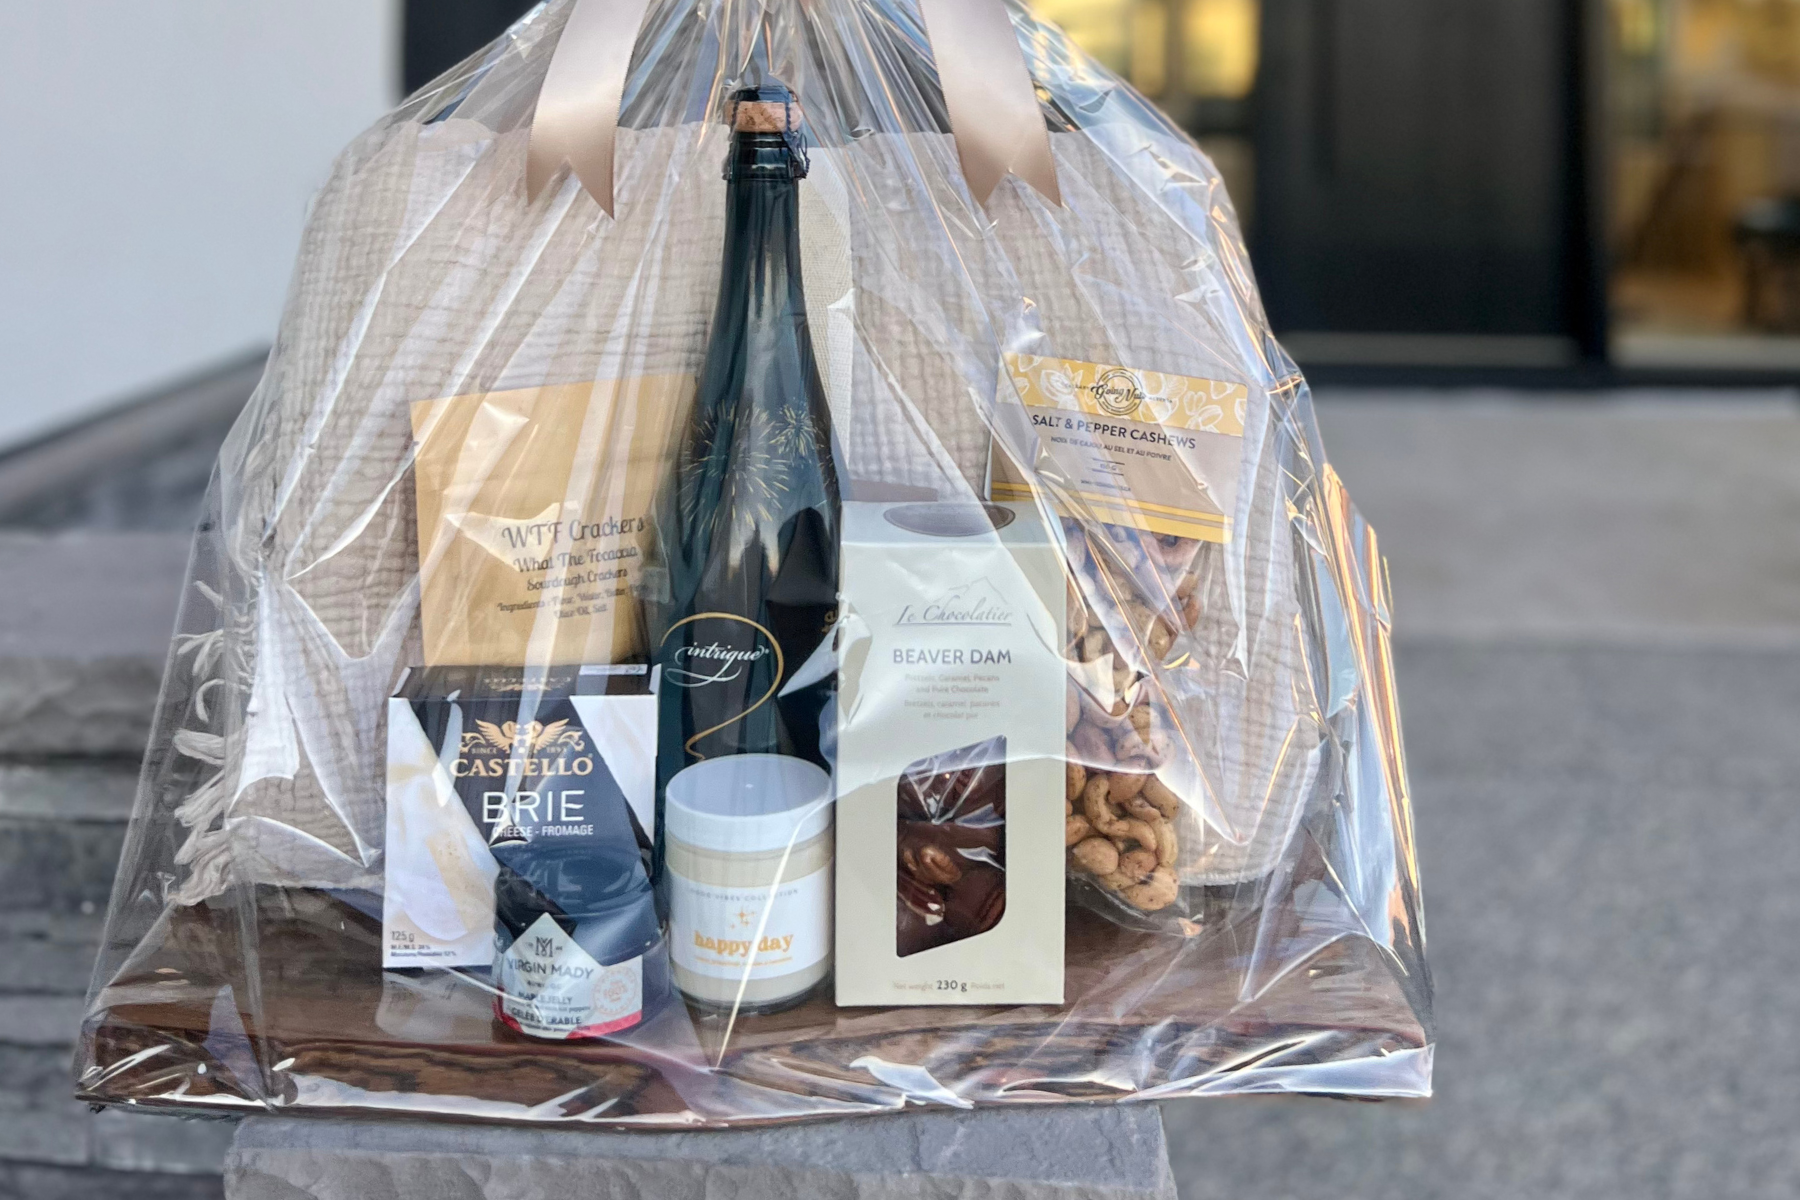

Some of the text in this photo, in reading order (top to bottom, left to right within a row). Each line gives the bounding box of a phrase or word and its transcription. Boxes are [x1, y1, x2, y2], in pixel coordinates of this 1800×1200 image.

[1090, 384, 1124, 403] Going
[1032, 414, 1196, 449] SALT & PEPPER CASHEWS
[1146, 451, 1171, 461] POIVRE
[502, 516, 644, 548] WTF Crackers
[514, 556, 554, 573] What
[556, 552, 585, 567] The
[587, 567, 628, 583] Crackers
[923, 595, 1012, 621] Chocolatier
[666, 642, 764, 687] intrigue
[893, 649, 1012, 665] BEAVER DAM
[449, 757, 593, 777] CASTELLO
[483, 790, 585, 823] BRIE
[493, 825, 533, 838] CHEESE
[541, 824, 594, 837] FROMAGE
[391, 930, 415, 943] 125 g
[694, 930, 794, 957] happy day
[506, 959, 546, 974] VIRGIN
[551, 964, 595, 979] MADY
[936, 980, 958, 991] 230
[960, 982, 968, 993] g
